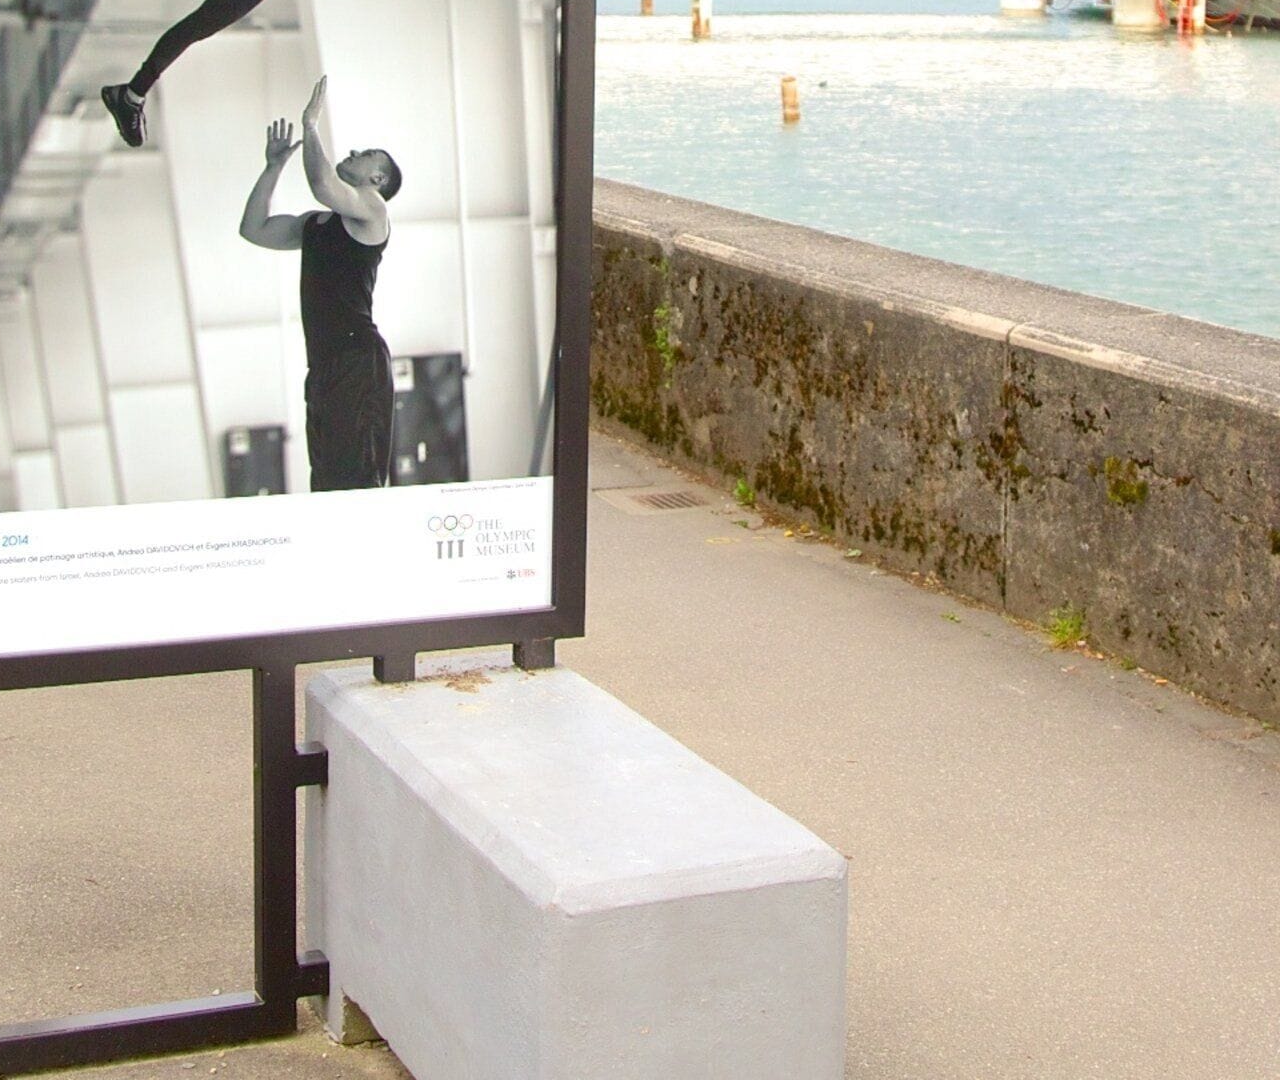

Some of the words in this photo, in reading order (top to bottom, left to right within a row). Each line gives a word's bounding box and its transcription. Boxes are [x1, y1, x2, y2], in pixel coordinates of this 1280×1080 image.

[477, 519, 503, 530] THE
[2, 535, 29, 547] 2014
[475, 529, 535, 543] OLYMPIC
[28, 555, 38, 563] de
[40, 552, 75, 562] patinage
[117, 547, 144, 556] Andrea
[146, 543, 194, 554] DAVIDOVICH
[476, 542, 535, 556] MUSEUM
